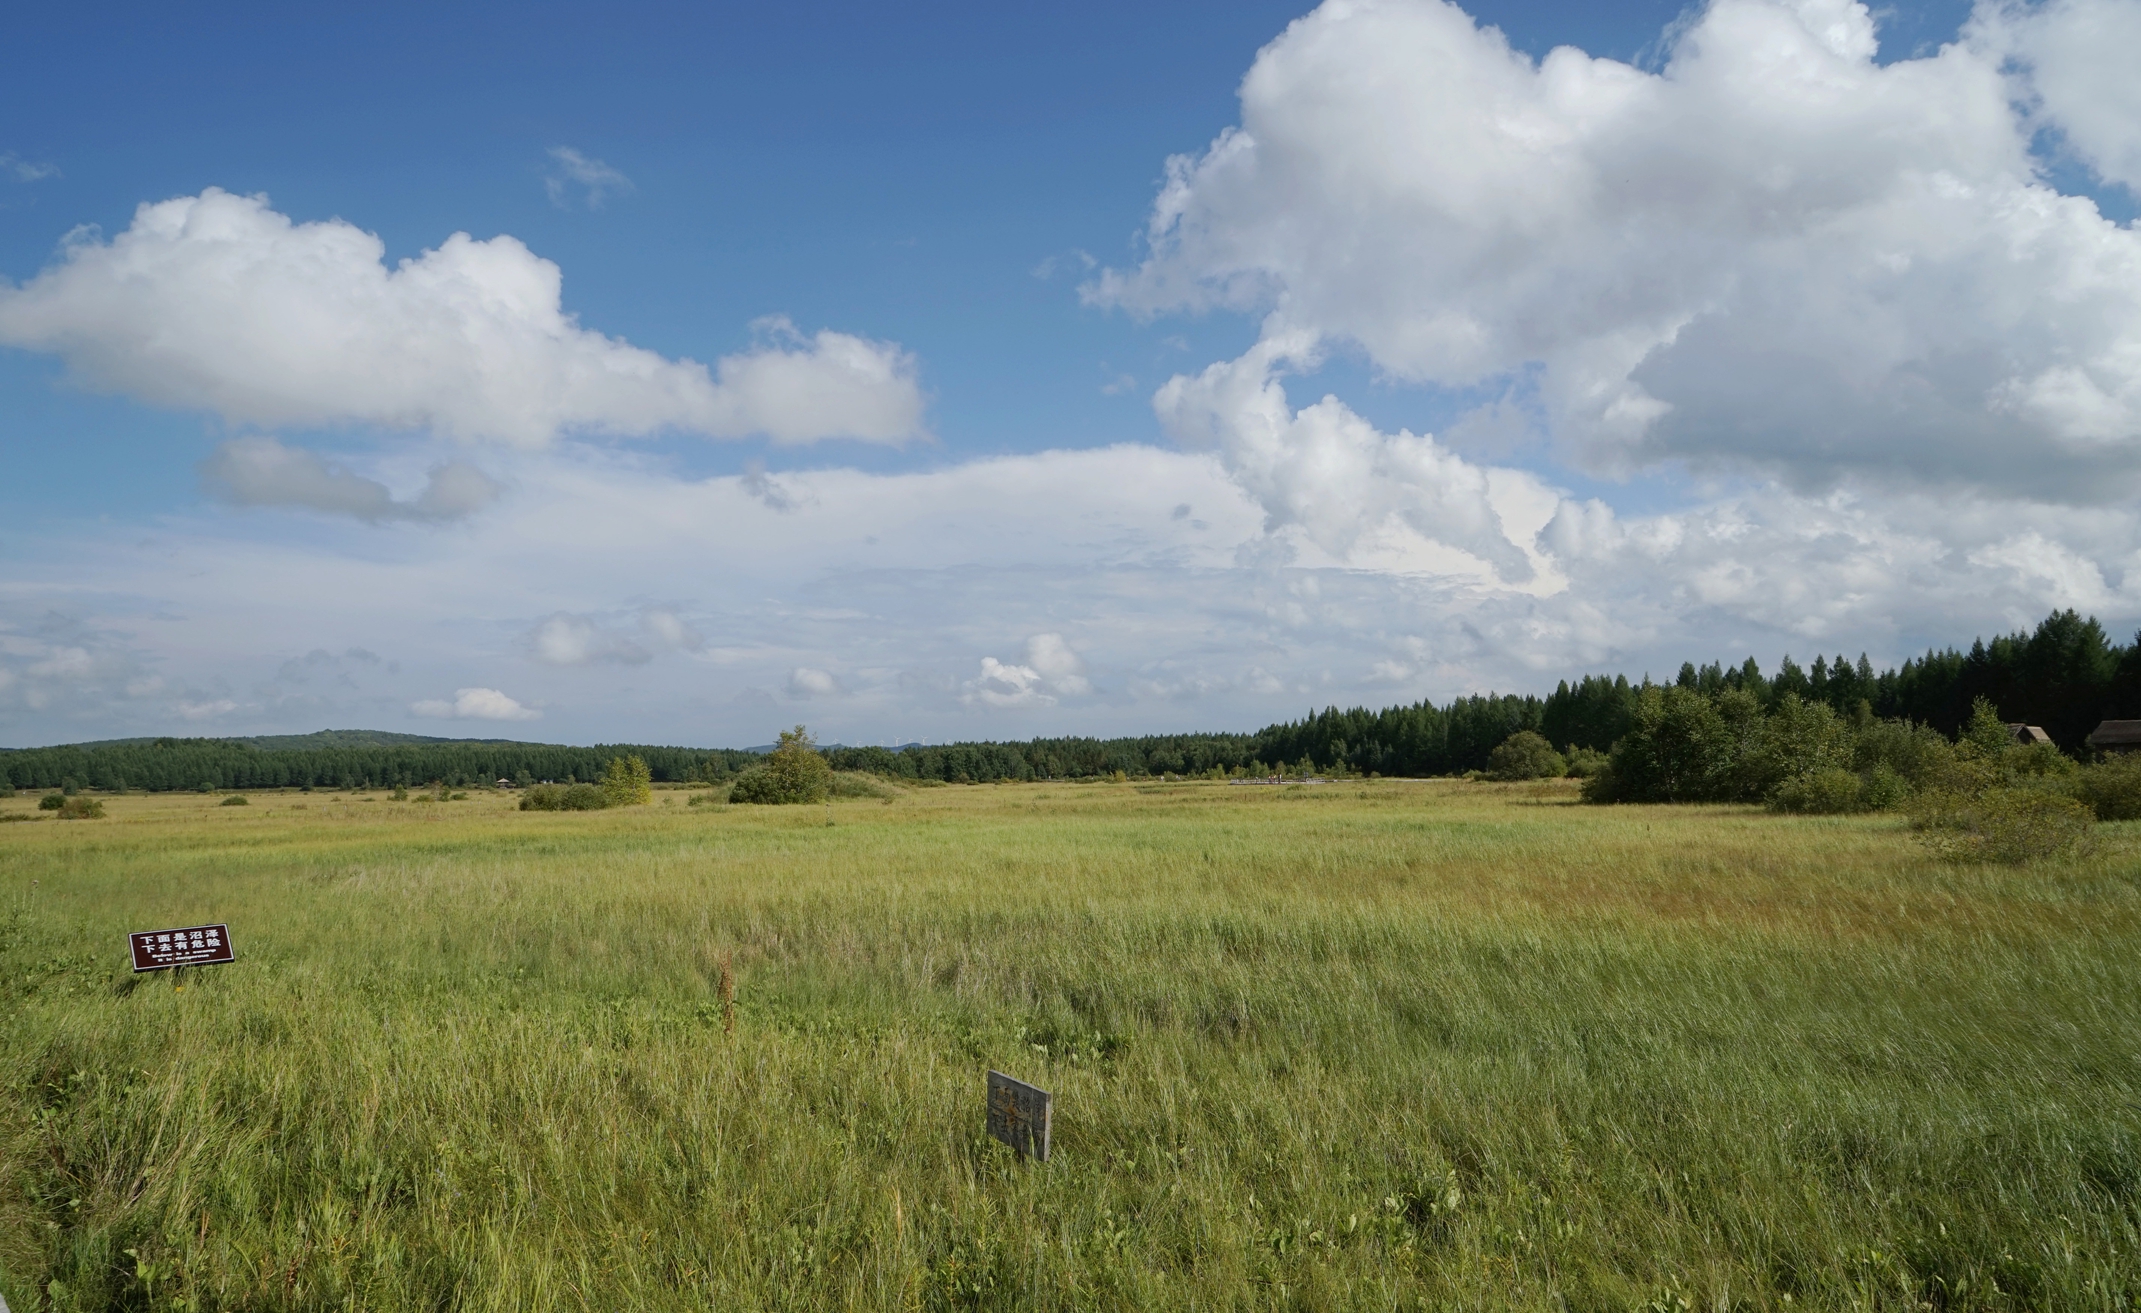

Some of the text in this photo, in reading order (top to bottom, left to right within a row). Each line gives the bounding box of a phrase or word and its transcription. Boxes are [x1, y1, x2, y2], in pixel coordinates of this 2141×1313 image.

[139, 929, 219, 945] 下面是沼泽
[141, 938, 221, 954] 下去有危险
